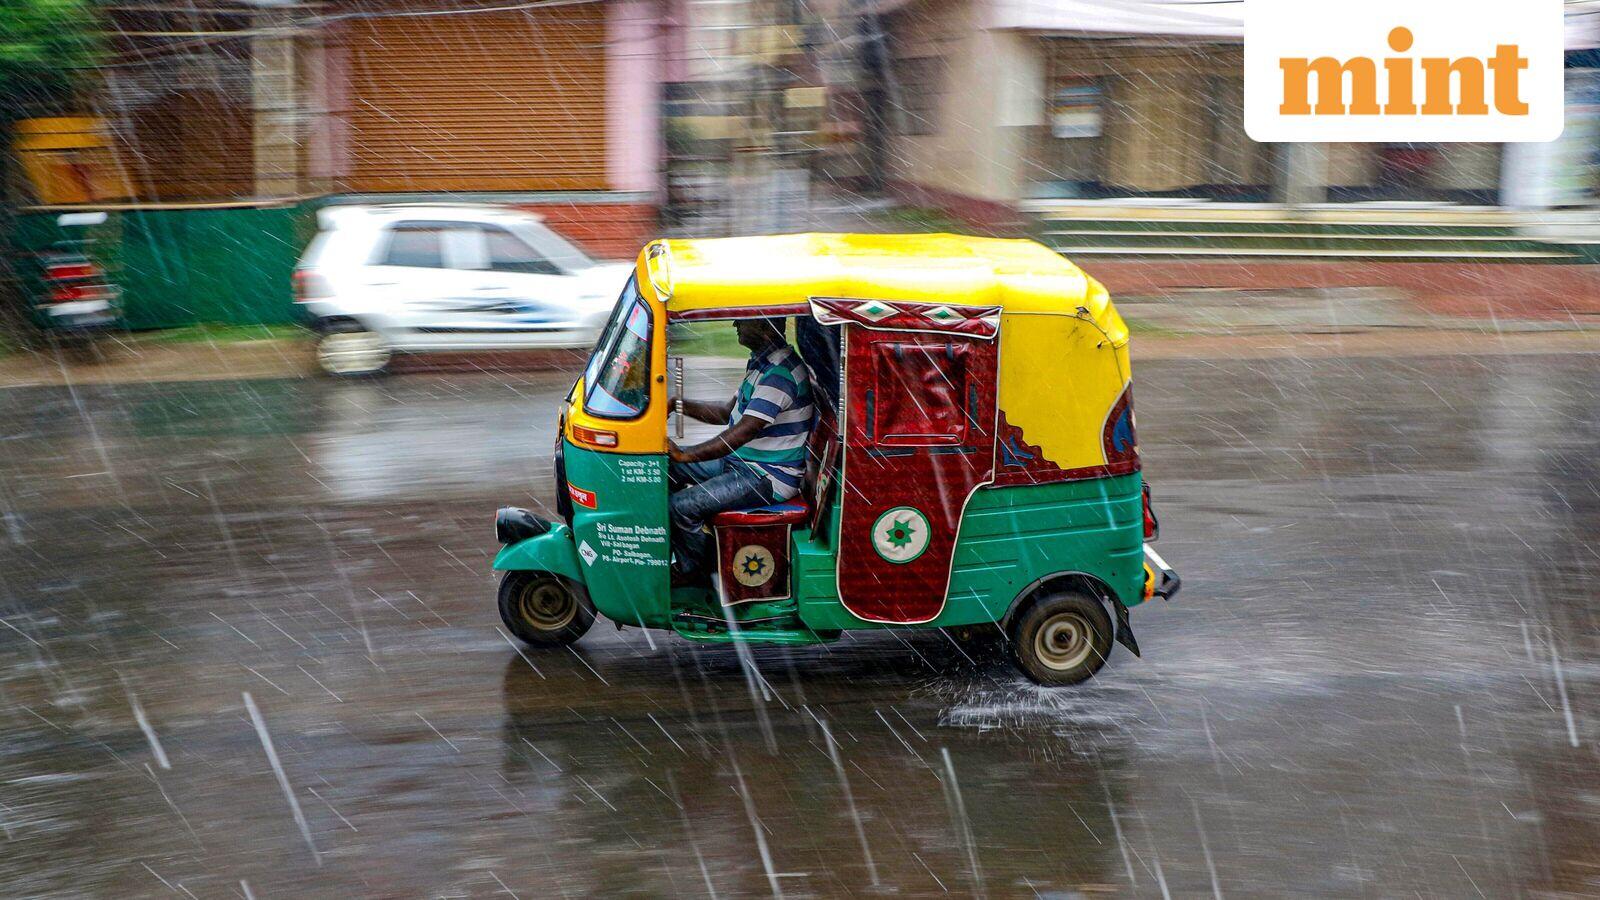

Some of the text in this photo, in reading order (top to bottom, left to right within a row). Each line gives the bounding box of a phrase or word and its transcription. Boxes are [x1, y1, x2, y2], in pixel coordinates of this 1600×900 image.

[597, 522, 666, 535] Sri Suman Debnath
